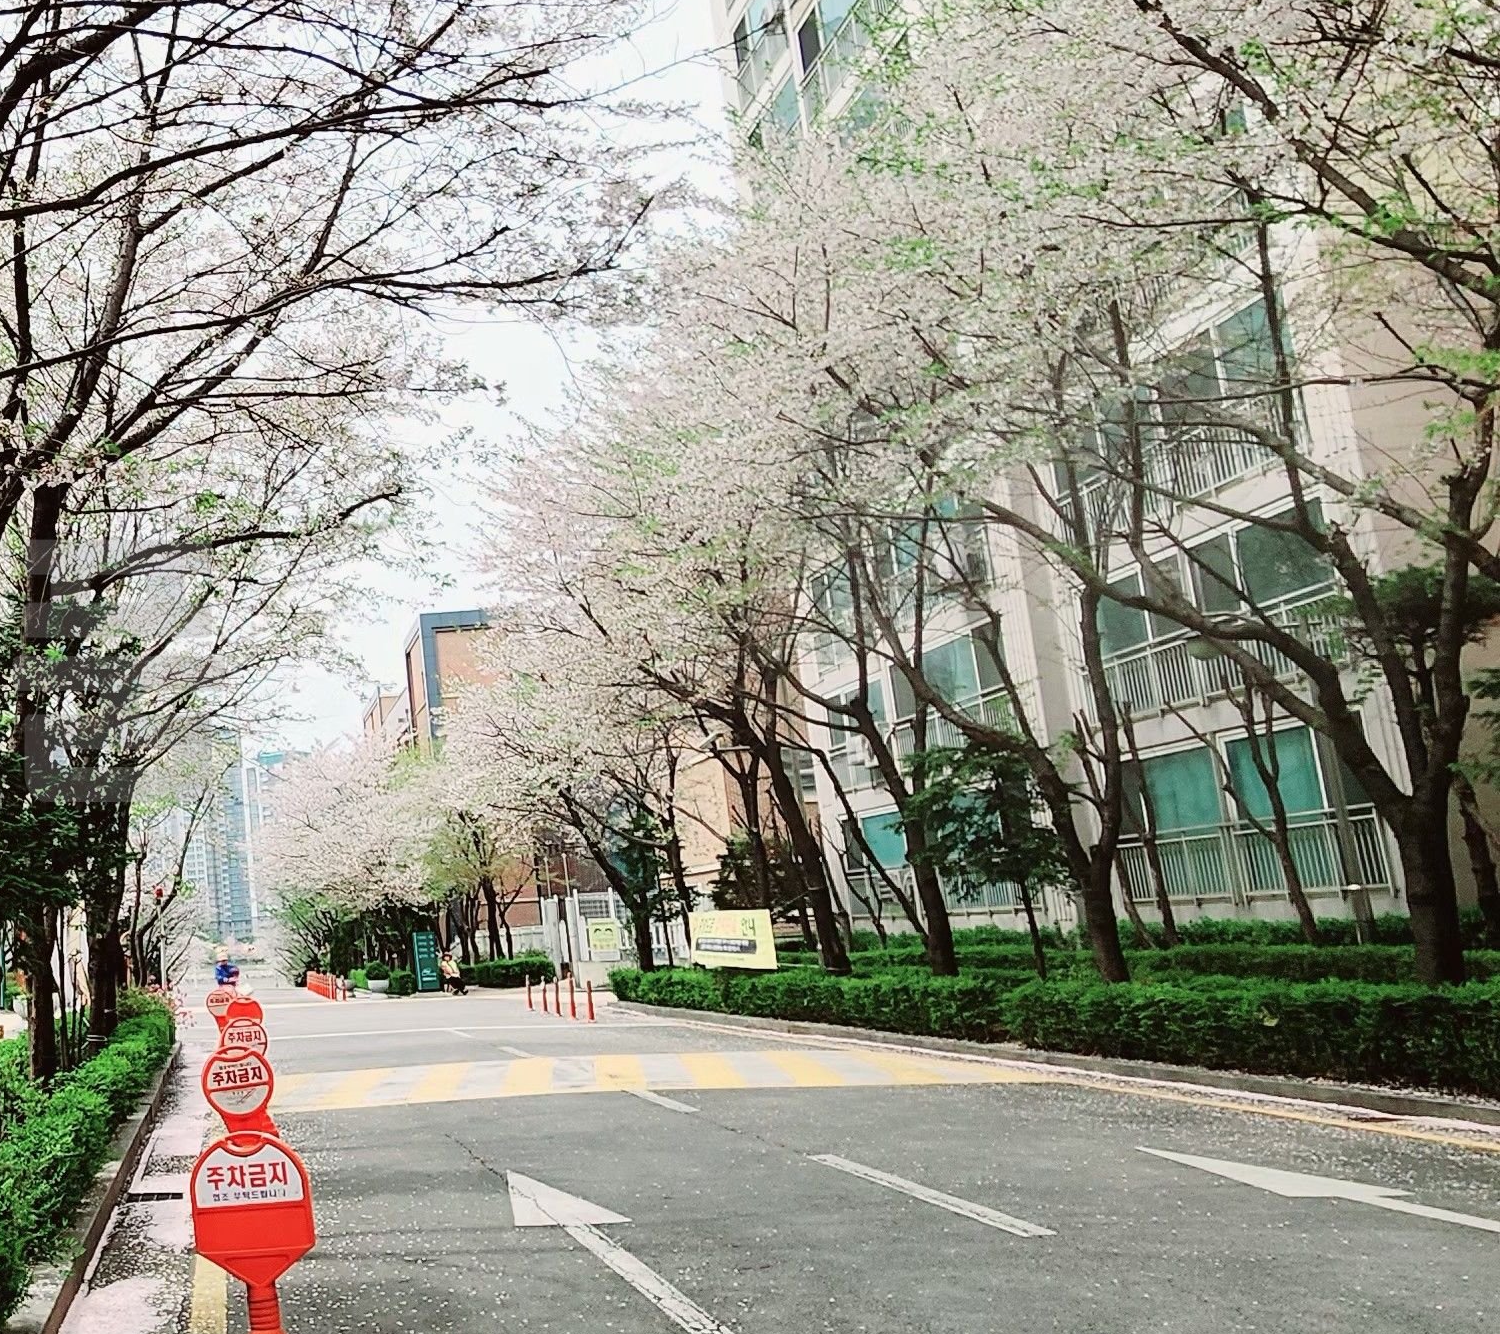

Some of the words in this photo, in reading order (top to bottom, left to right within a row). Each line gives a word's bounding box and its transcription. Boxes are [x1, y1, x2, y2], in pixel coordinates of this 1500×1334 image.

[227, 1030, 261, 1043] 주차금지
[212, 1065, 263, 1087] 주차금지
[206, 1161, 288, 1191] 주차금지
